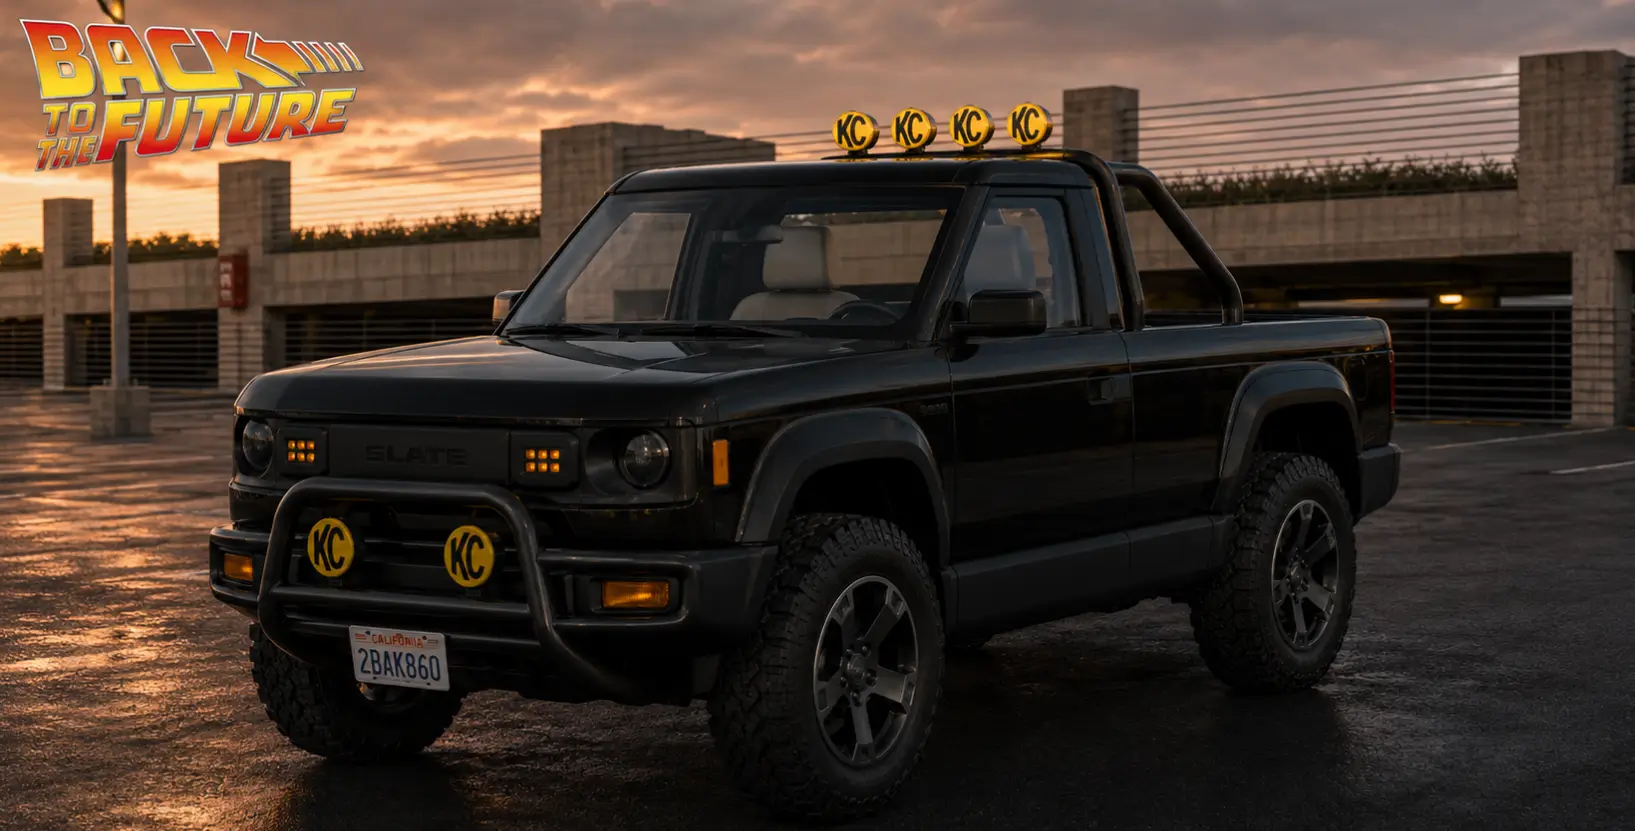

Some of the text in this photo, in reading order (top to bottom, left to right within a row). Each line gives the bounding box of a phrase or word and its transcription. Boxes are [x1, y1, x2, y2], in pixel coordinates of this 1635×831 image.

[837, 114, 866, 148] KC
[895, 111, 923, 146] KC
[954, 108, 982, 144] KC
[1012, 106, 1040, 142] KC
[365, 445, 468, 466] SLATE
[313, 524, 345, 571] KC
[451, 532, 484, 580] KC
[358, 648, 441, 681] 2BAK860
